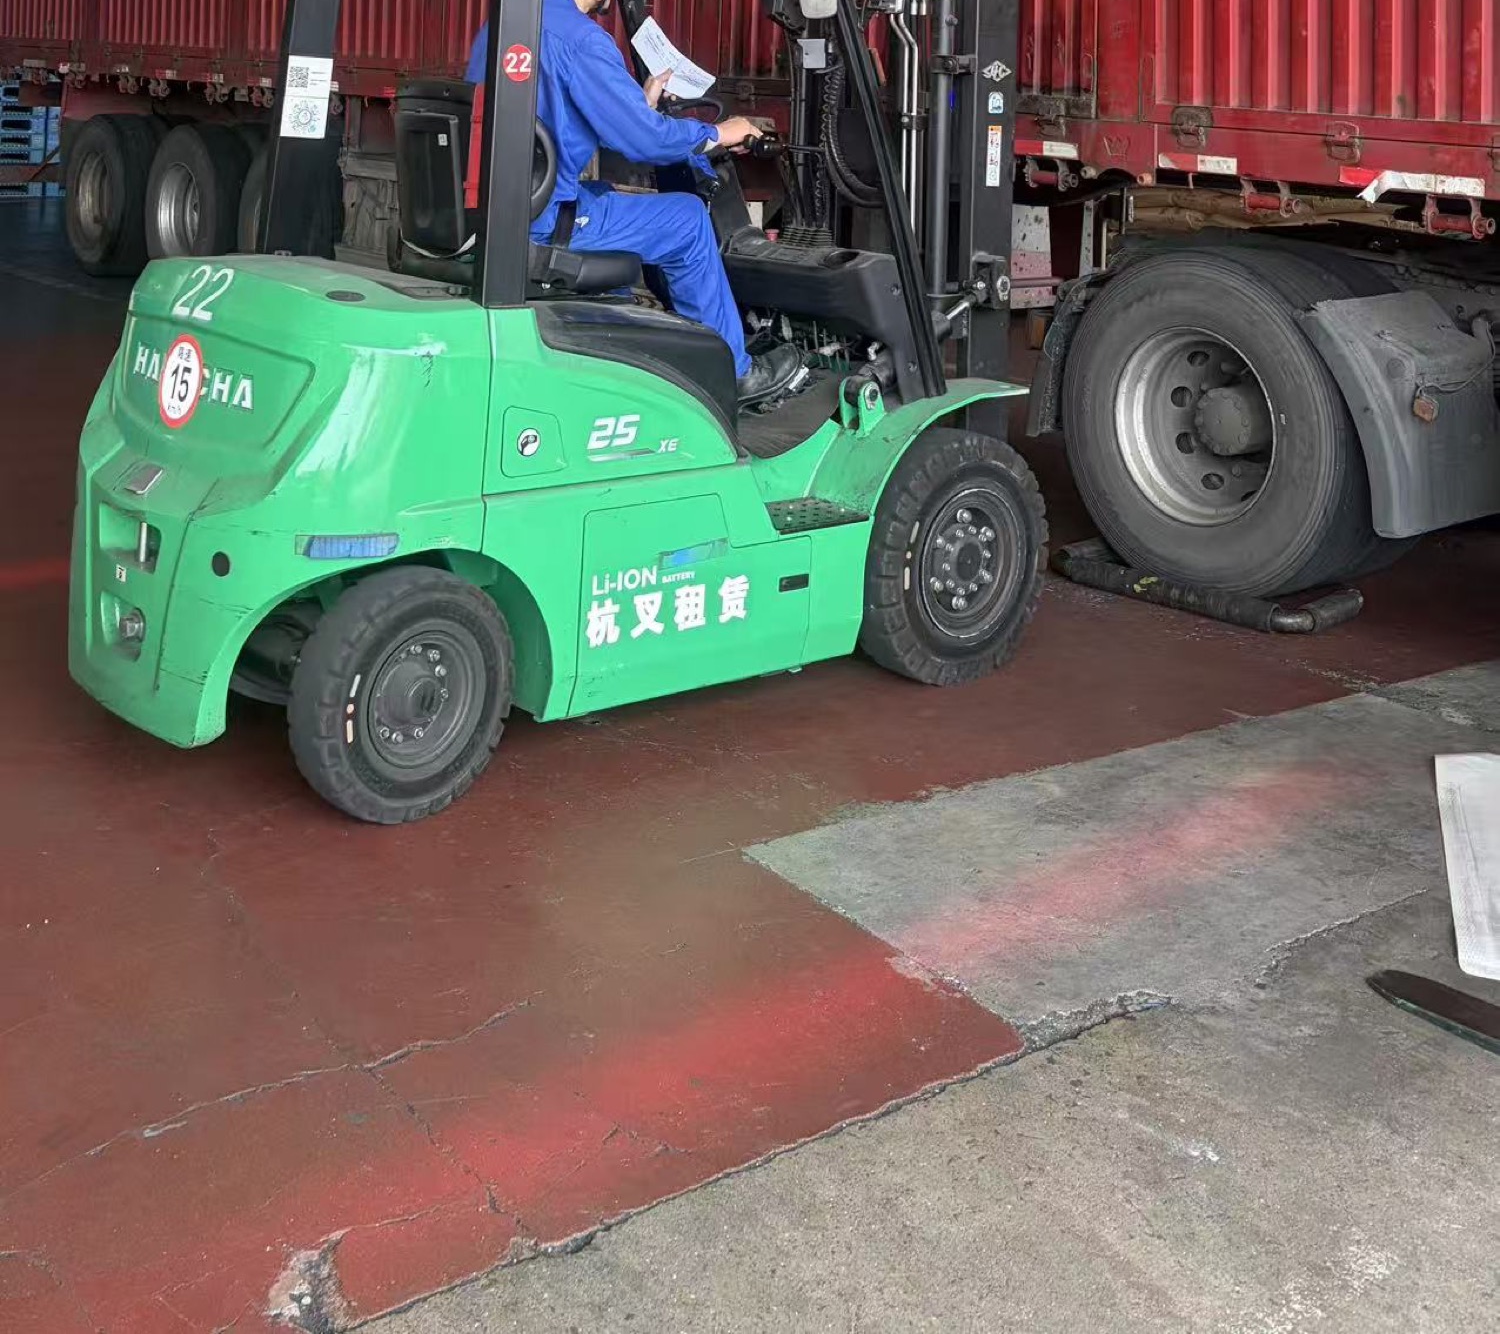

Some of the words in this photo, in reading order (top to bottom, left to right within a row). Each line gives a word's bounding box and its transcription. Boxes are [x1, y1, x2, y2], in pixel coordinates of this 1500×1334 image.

[506, 52, 531, 73] 22
[171, 264, 236, 322] 22
[170, 363, 192, 403] 15
[587, 414, 640, 450] 25
[657, 438, 680, 454] XE
[591, 565, 658, 597] Li-ION
[661, 570, 696, 584] BATTERY
[585, 573, 750, 649] 杭叉租赁
